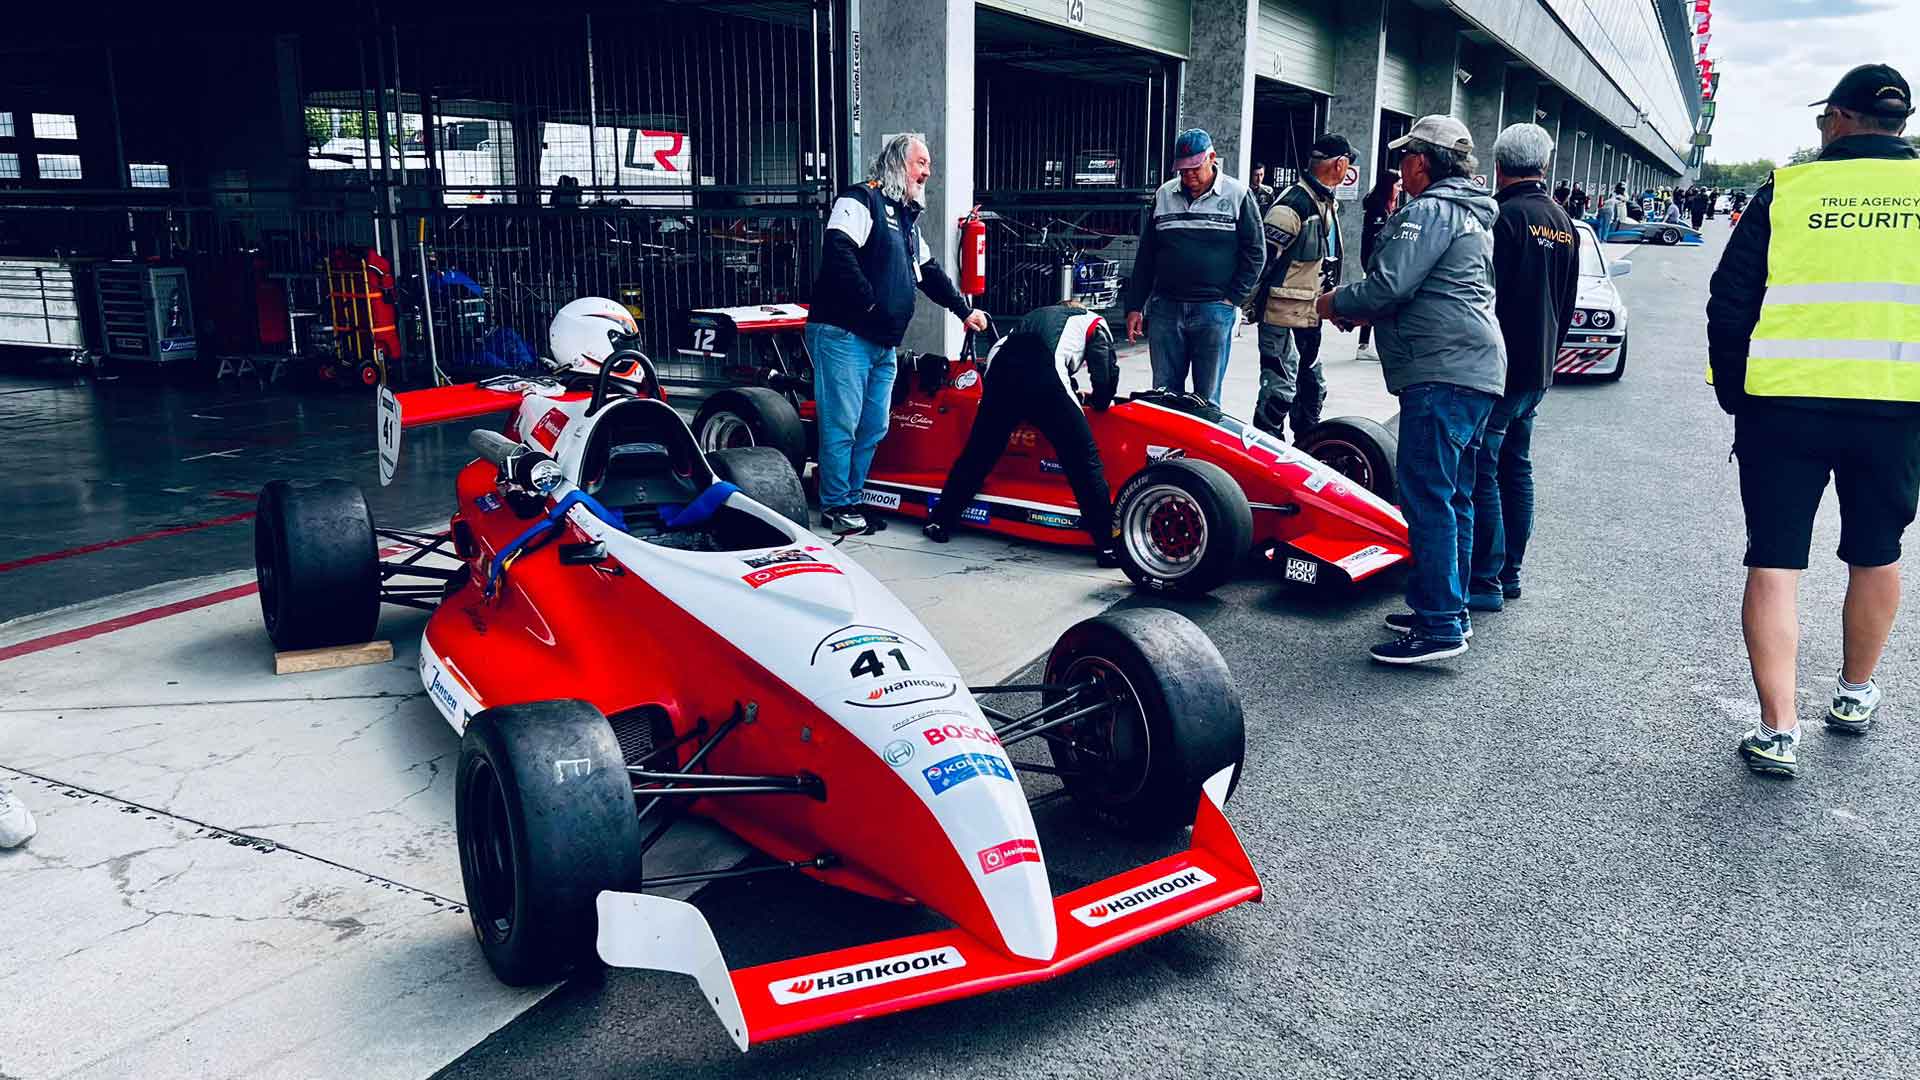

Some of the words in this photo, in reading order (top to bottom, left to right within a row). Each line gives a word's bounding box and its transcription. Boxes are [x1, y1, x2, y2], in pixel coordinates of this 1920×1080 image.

[1821, 197, 1857, 207] TRUE
[1861, 197, 1920, 208] AGENCY
[694, 328, 716, 351] 12
[383, 416, 393, 449] 41
[1115, 474, 1150, 518] MICHELIN
[1031, 513, 1074, 525] RAVENOL
[1287, 569, 1314, 583] MOLY
[1288, 559, 1316, 573] LIQUI
[850, 648, 911, 678] 41
[429, 665, 457, 710] Jansen
[922, 724, 1001, 746] BOSCH
